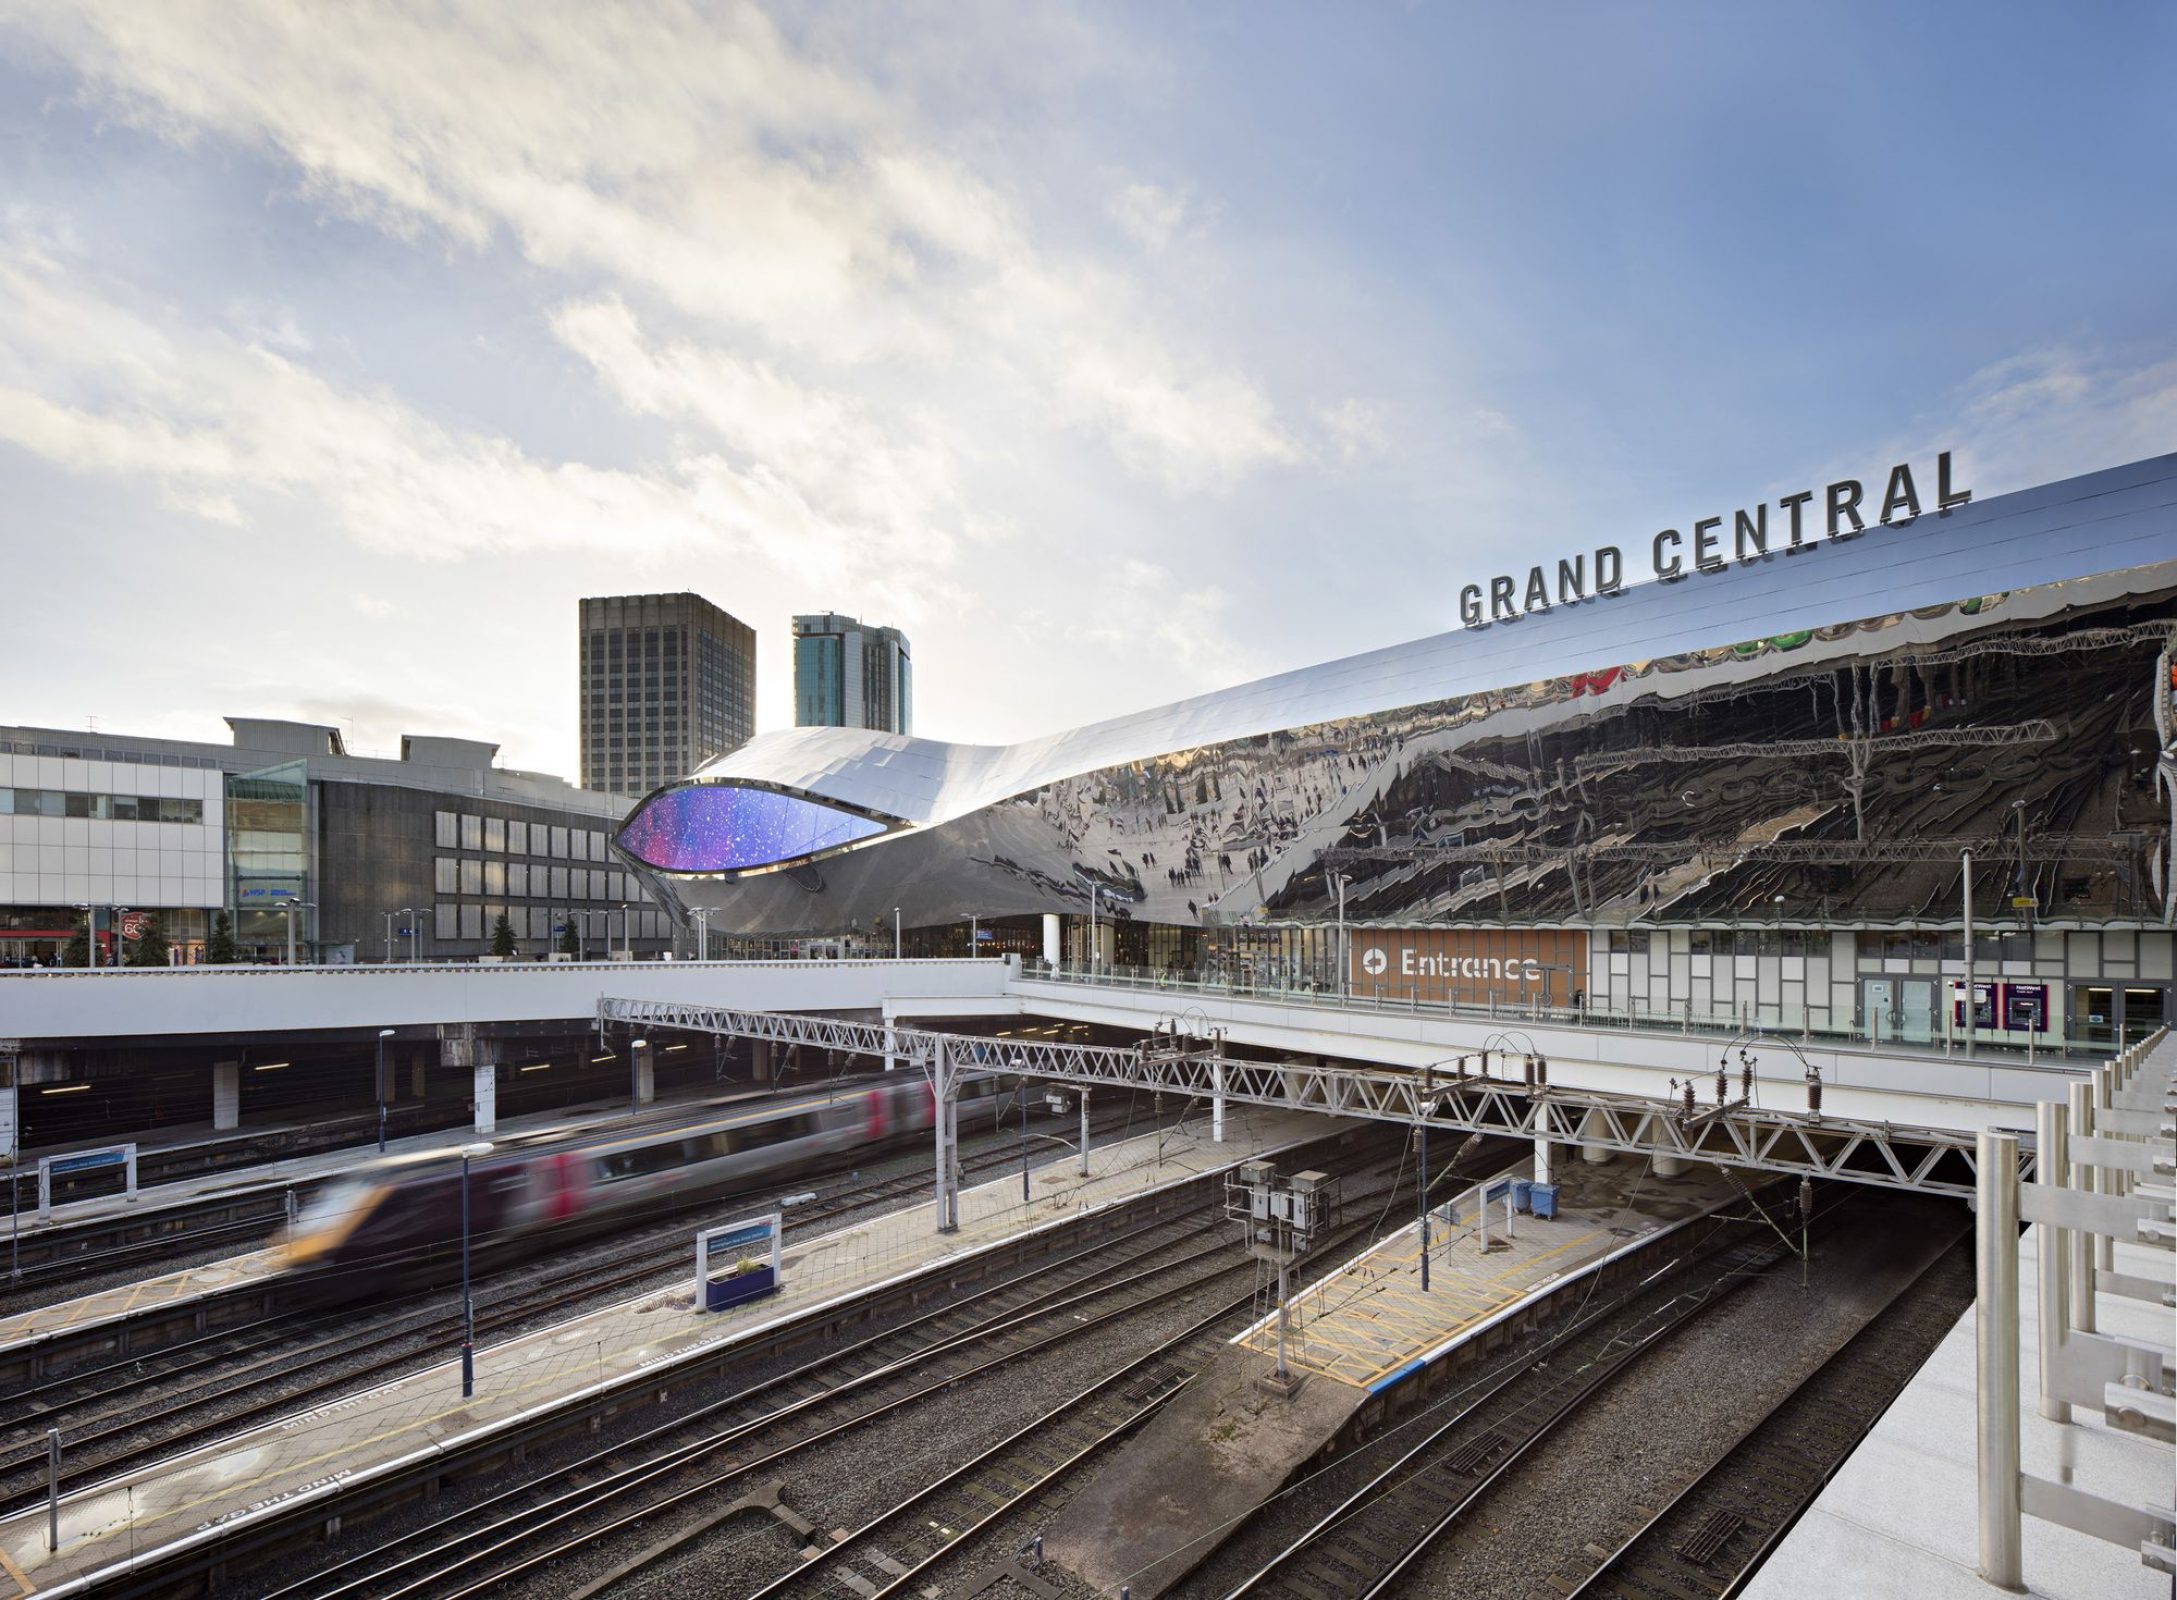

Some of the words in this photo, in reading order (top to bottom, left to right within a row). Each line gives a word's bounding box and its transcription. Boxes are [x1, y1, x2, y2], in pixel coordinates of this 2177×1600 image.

[1460, 545, 1624, 626] GRAND
[1653, 450, 1973, 578] CENTRAL
[1401, 948, 1541, 981] Entrance
[298, 1469, 351, 1492] MIND
[249, 1492, 294, 1510] THE
